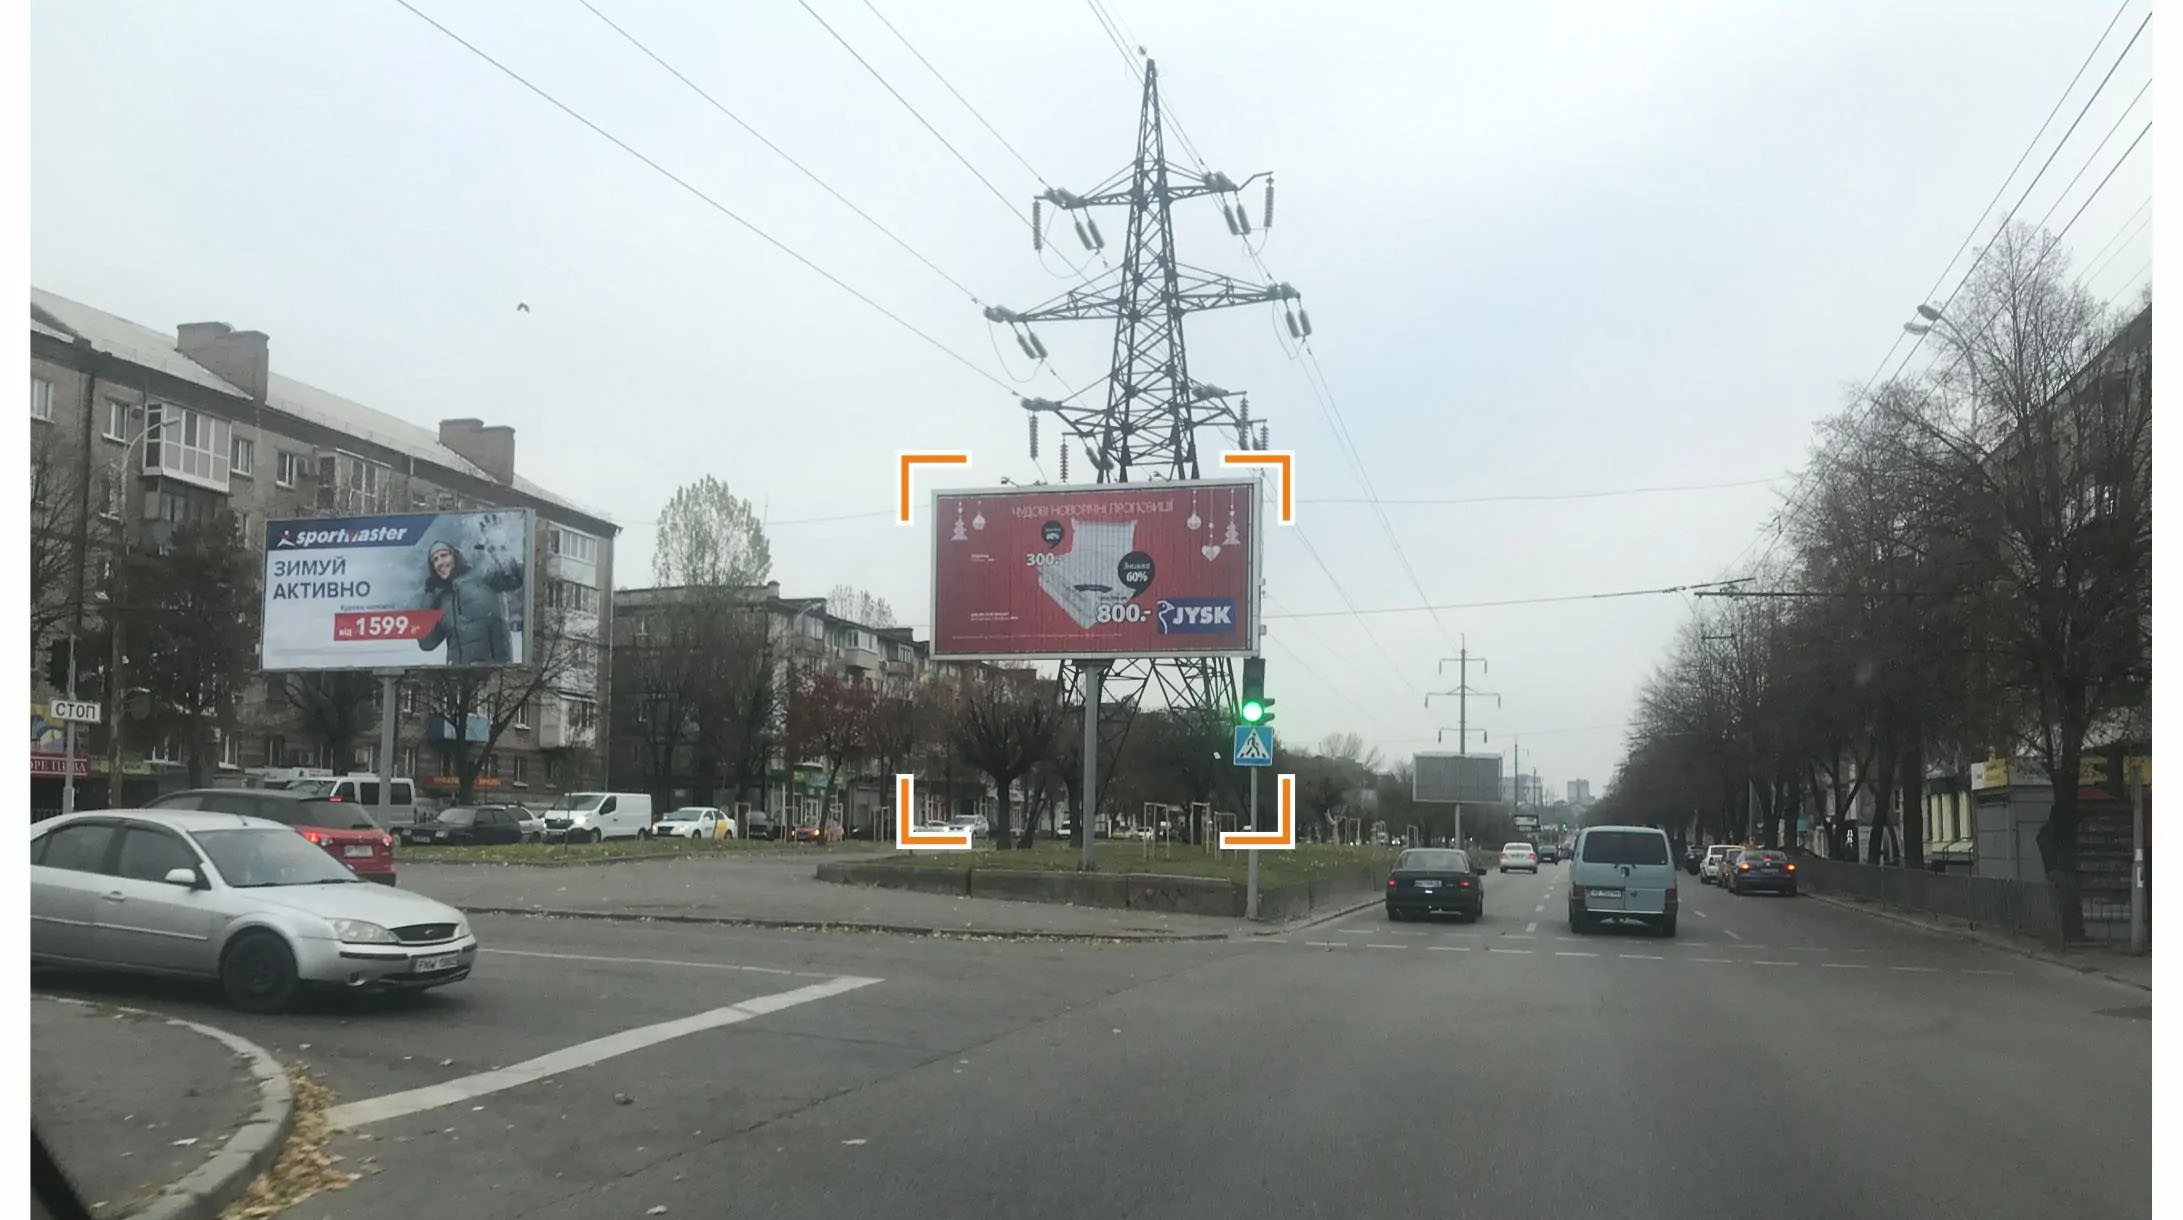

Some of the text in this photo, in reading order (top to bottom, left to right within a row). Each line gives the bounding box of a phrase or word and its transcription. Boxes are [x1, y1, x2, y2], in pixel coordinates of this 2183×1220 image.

[273, 555, 346, 577] ЗИМУЙ
[1126, 571, 1148, 582] 60%
[273, 581, 371, 600] АКТИВНО
[1172, 606, 1232, 624] JYSK
[56, 702, 96, 719] СТОП
